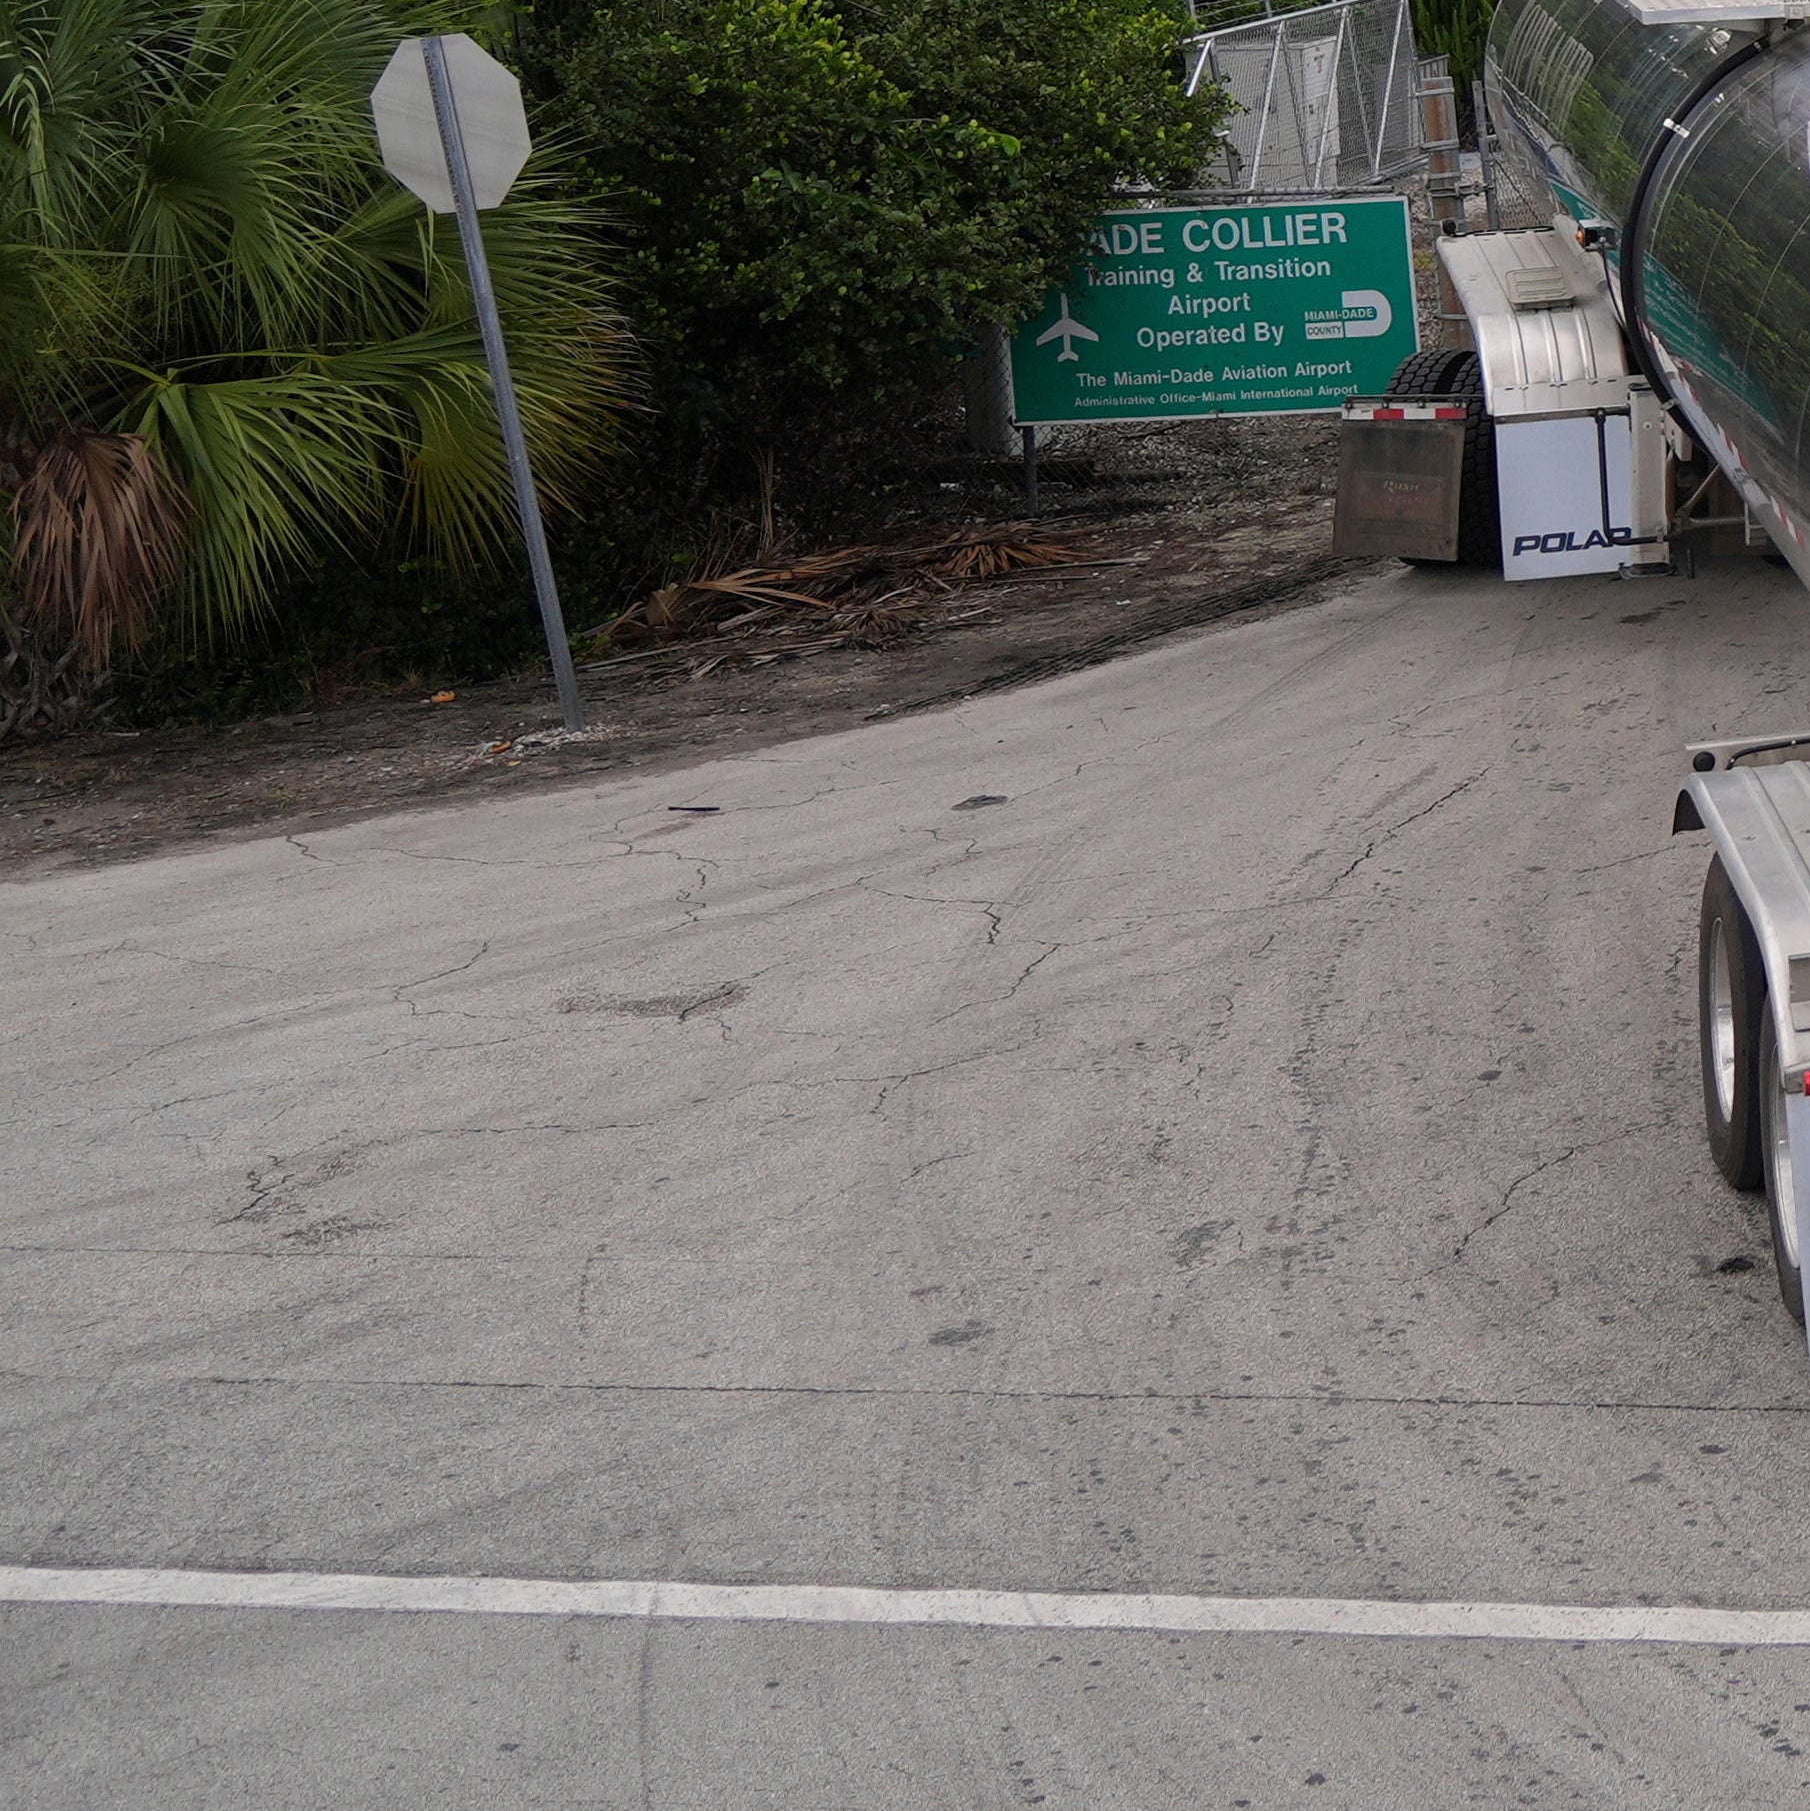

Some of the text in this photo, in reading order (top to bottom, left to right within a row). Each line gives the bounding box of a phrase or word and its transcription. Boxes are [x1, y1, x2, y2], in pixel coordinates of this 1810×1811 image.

[1077, 212, 1347, 256] ADE COLLIER
[1186, 262, 1204, 283] &
[1214, 257, 1331, 281] Transition
[1168, 293, 1250, 318] Airport
[1304, 308, 1375, 321] MIAMI-DADE
[1136, 322, 1284, 351] Operated By
[1307, 326, 1341, 336] COUNTY
[1076, 360, 1353, 387] The Miami-Dade Aviation Airport
[1074, 393, 1156, 407] Administrative
[1240, 386, 1314, 400] International
[1317, 384, 1359, 397] Airport
